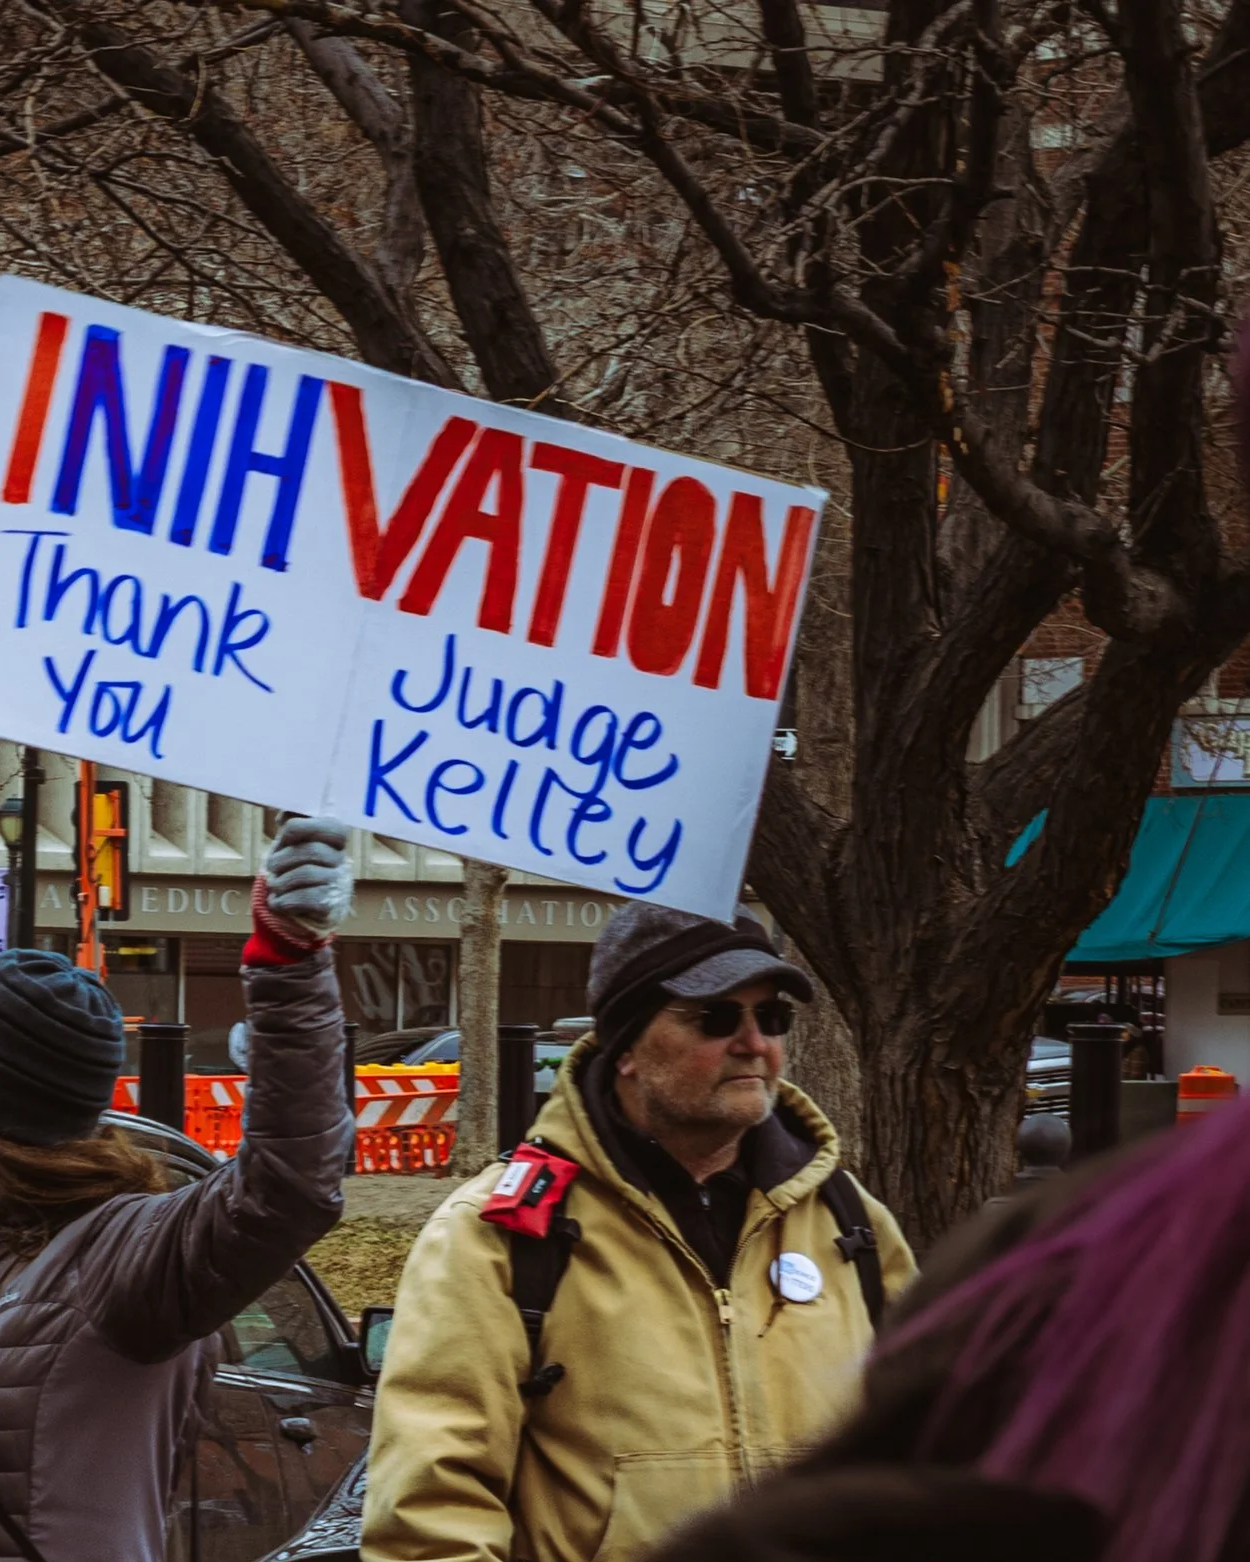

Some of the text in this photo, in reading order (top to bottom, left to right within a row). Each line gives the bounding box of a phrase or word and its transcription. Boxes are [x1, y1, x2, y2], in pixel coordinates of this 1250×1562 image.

[1, 311, 815, 700] INIHVATION
[42, 649, 171, 759] You
[391, 633, 679, 800] Judge
[364, 719, 683, 894] Kelley
